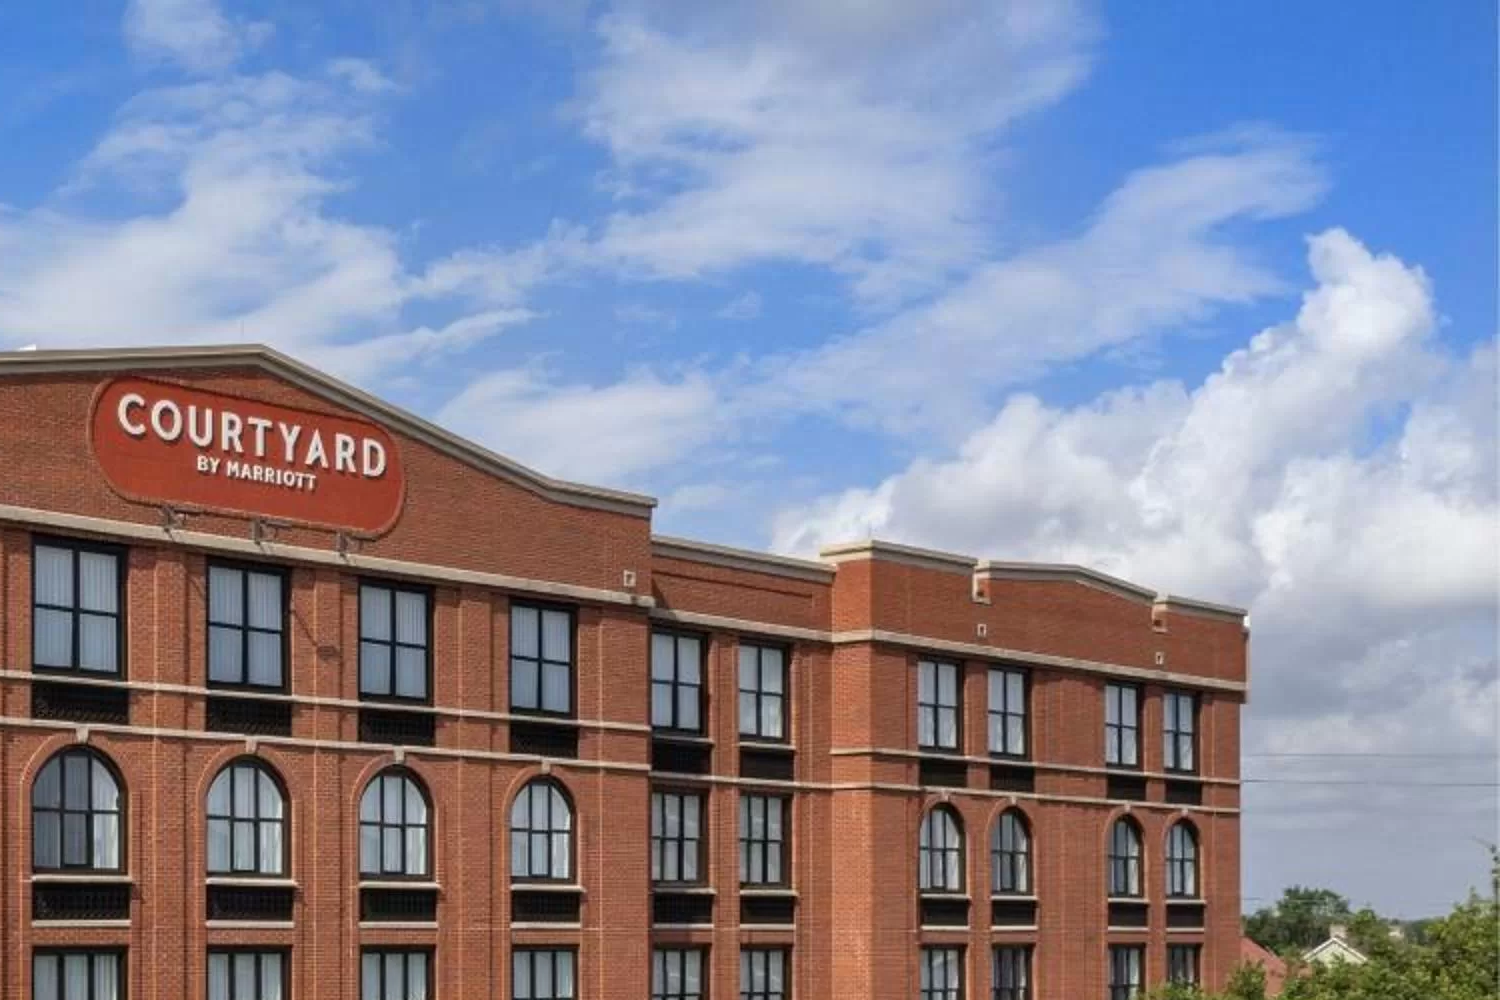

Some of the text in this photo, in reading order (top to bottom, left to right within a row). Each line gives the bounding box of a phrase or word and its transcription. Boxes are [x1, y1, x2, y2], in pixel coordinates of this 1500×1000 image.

[117, 394, 386, 477] COURTYARD
[197, 455, 316, 490] BY MARRIOTT
